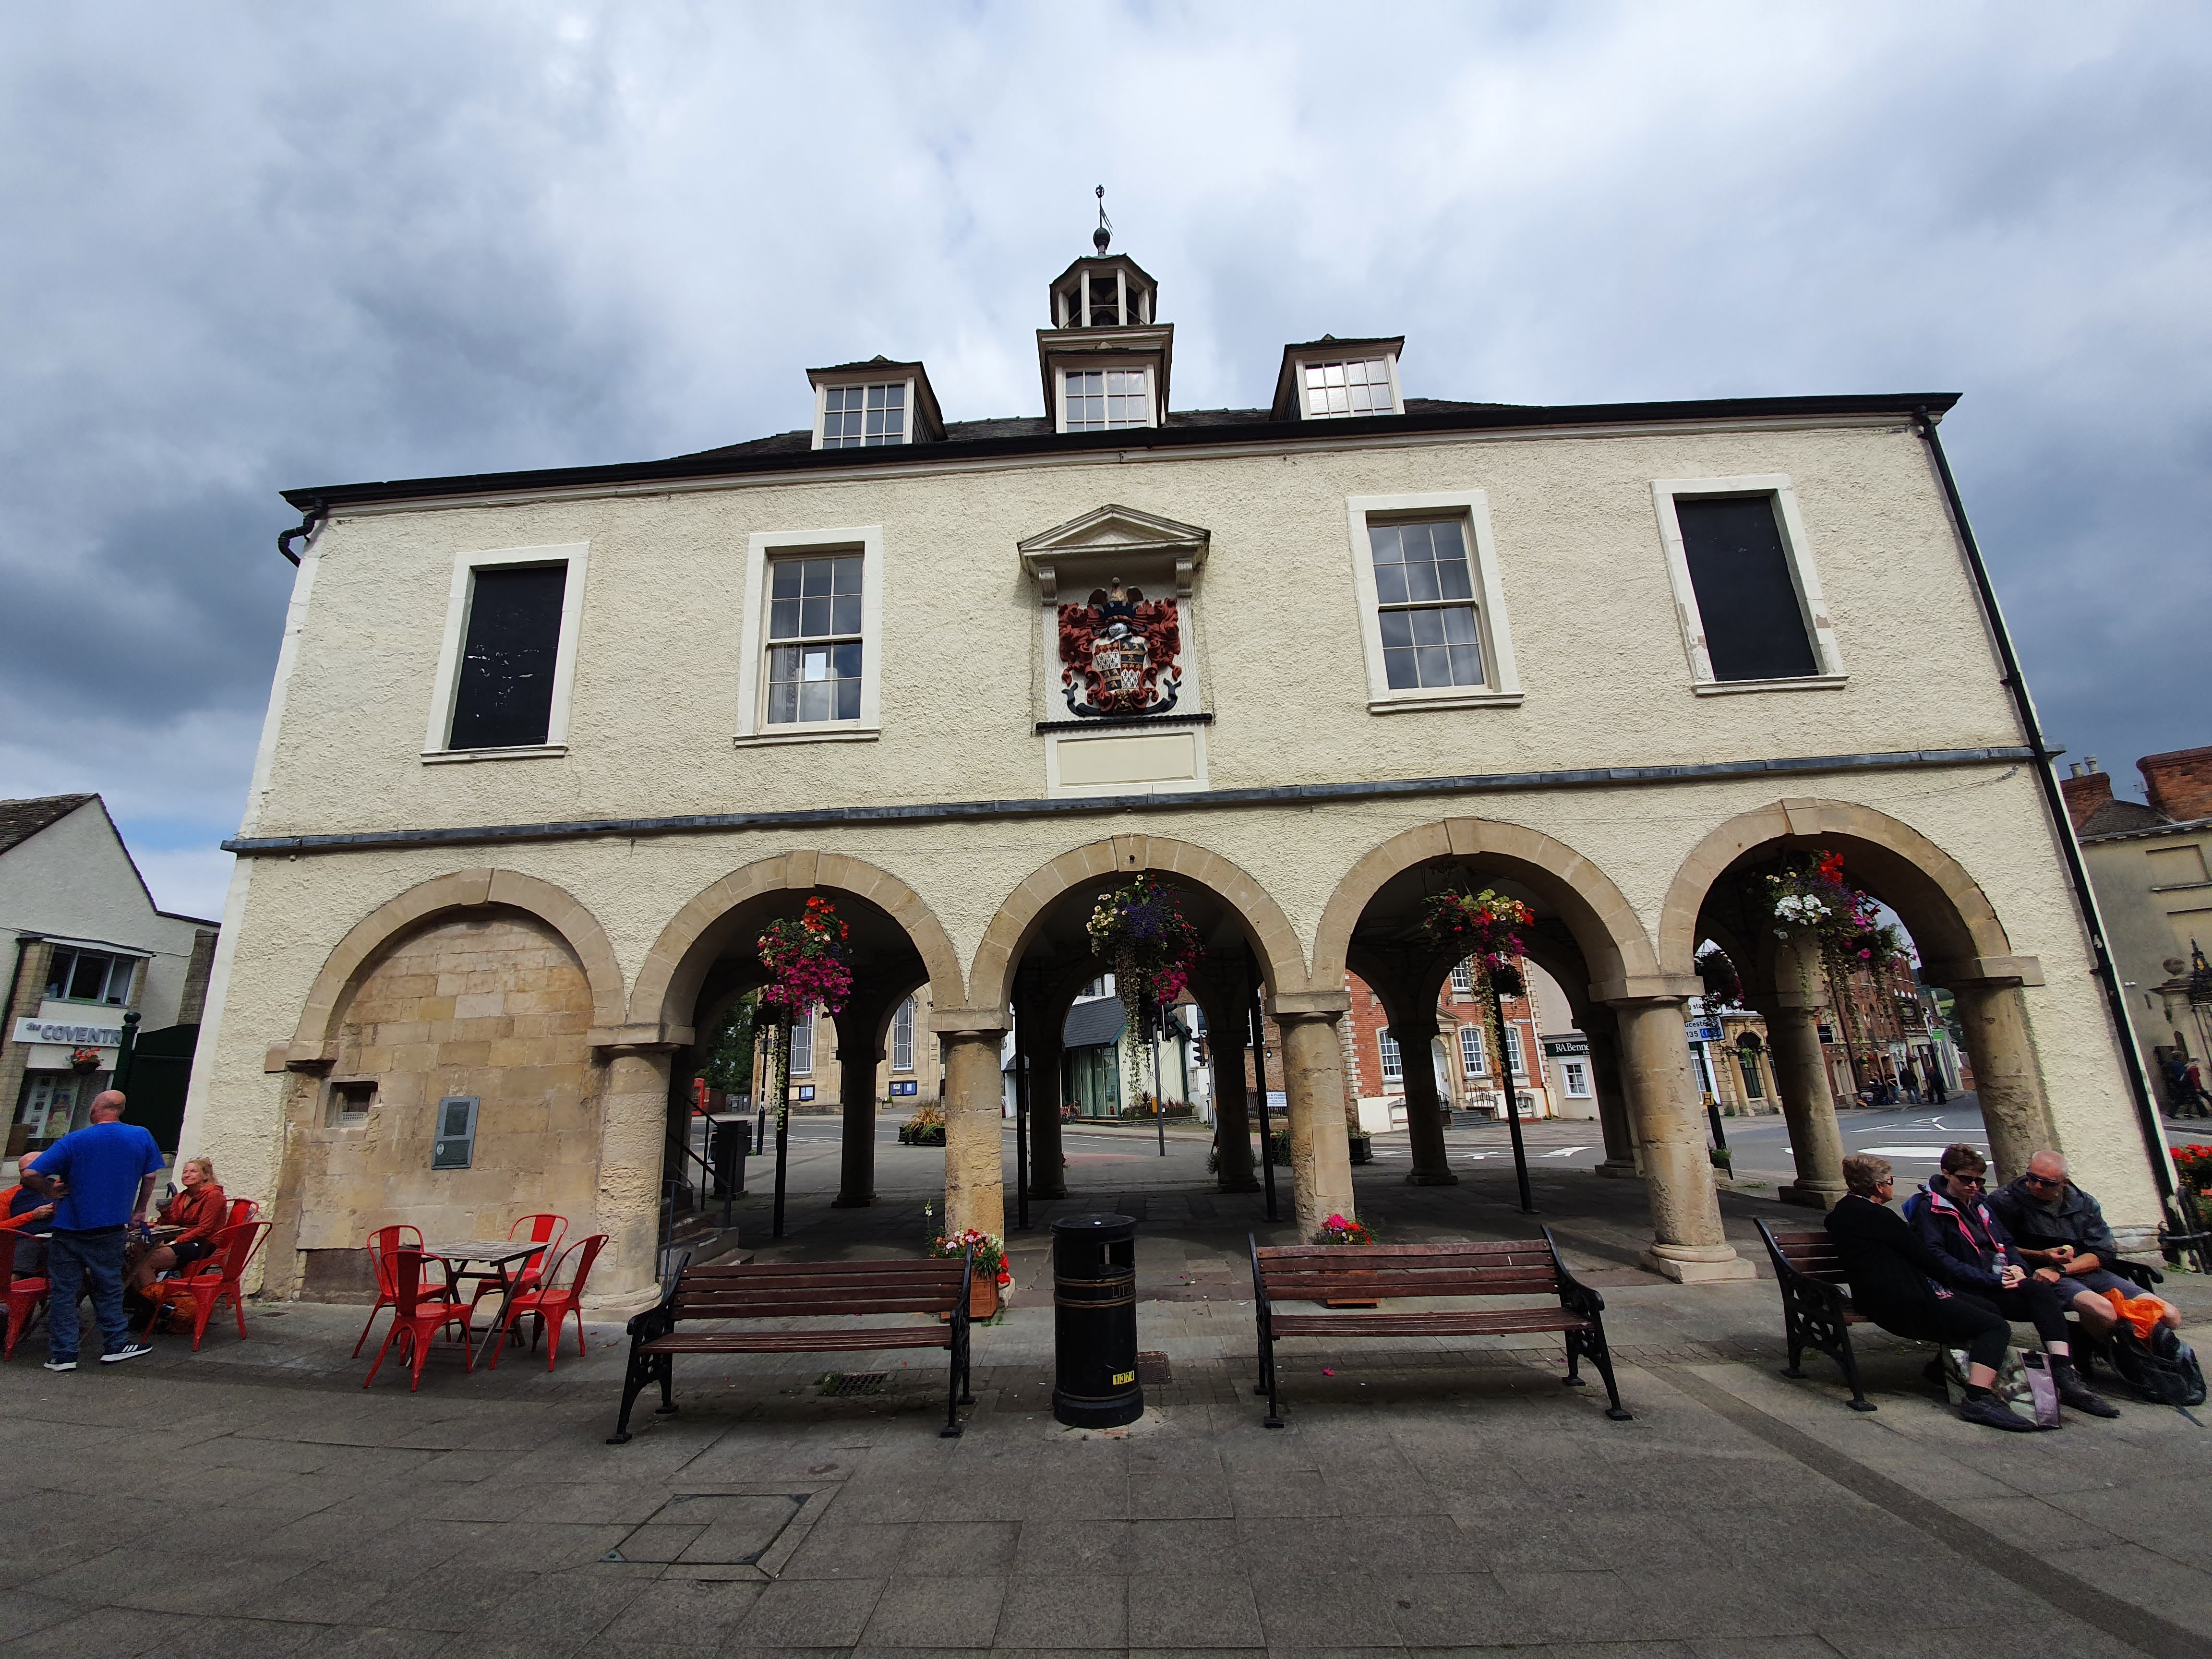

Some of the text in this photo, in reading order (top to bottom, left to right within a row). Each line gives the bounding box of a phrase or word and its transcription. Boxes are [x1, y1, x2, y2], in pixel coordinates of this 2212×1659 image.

[41, 1024, 121, 1044] COVENTR
[1703, 1094, 1712, 1104] H
[1111, 1283, 1135, 1298] LITTE
[1115, 1371, 1133, 1384] 1374
